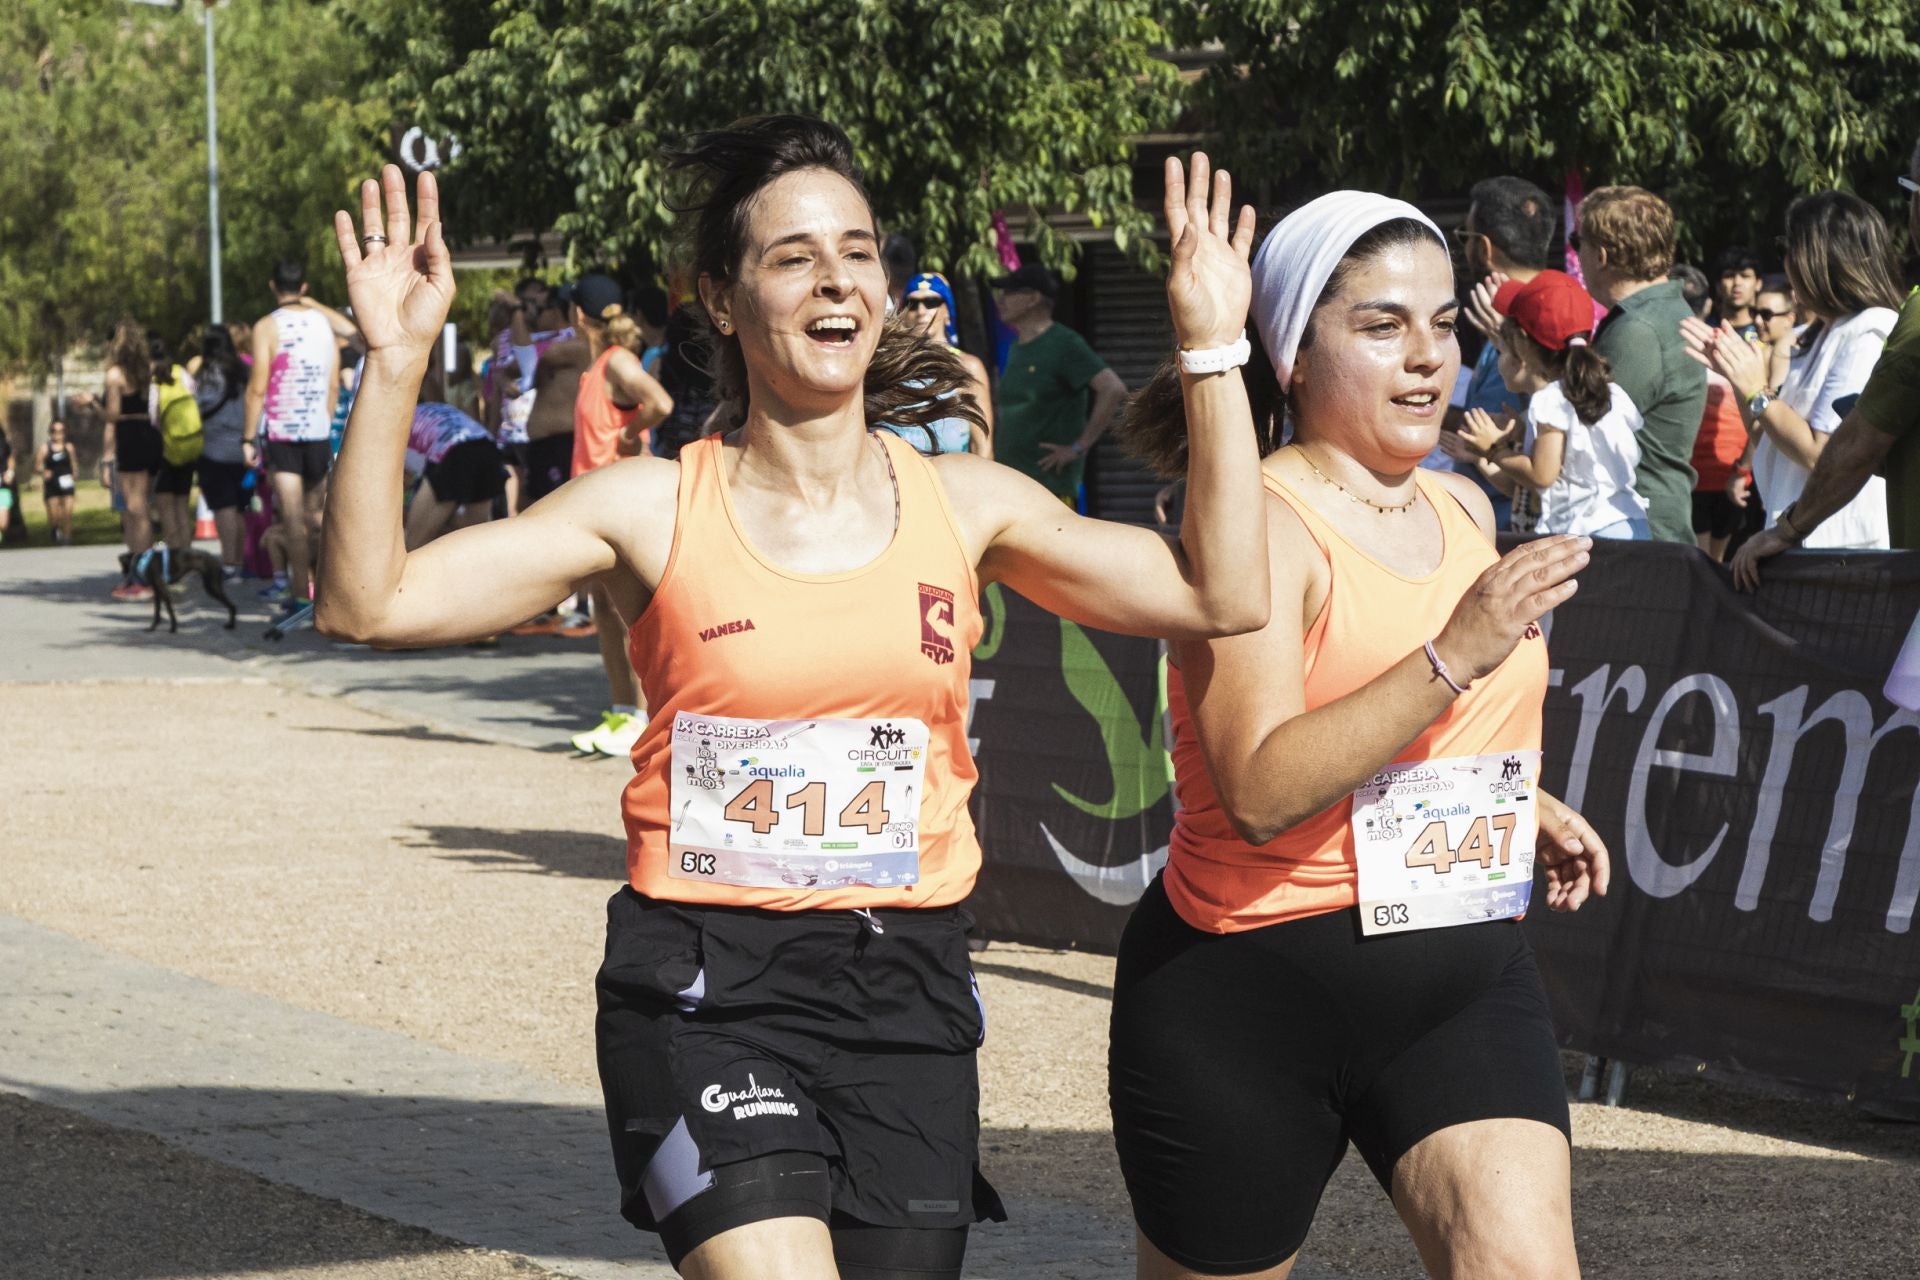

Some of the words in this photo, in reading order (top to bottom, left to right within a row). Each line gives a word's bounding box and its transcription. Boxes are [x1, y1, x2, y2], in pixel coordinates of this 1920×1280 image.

[698, 618, 756, 643] VANESA
[675, 718, 693, 734] IX
[694, 722, 771, 739] CARRERA
[715, 738, 788, 750] DIVERSIDAD
[748, 763, 805, 780] aqualia
[1372, 767, 1439, 786] CARRERA
[1391, 780, 1455, 796] DIVERSIDAD
[723, 779, 890, 837] 414
[1423, 803, 1471, 820] aqualia
[886, 822, 913, 833] JUNIO
[892, 832, 914, 849] 01
[1405, 812, 1517, 874] 447
[681, 851, 717, 876] 5K
[1374, 903, 1409, 926] 5K
[701, 1073, 785, 1113] Guadiana
[733, 1101, 799, 1120] RUNNING
